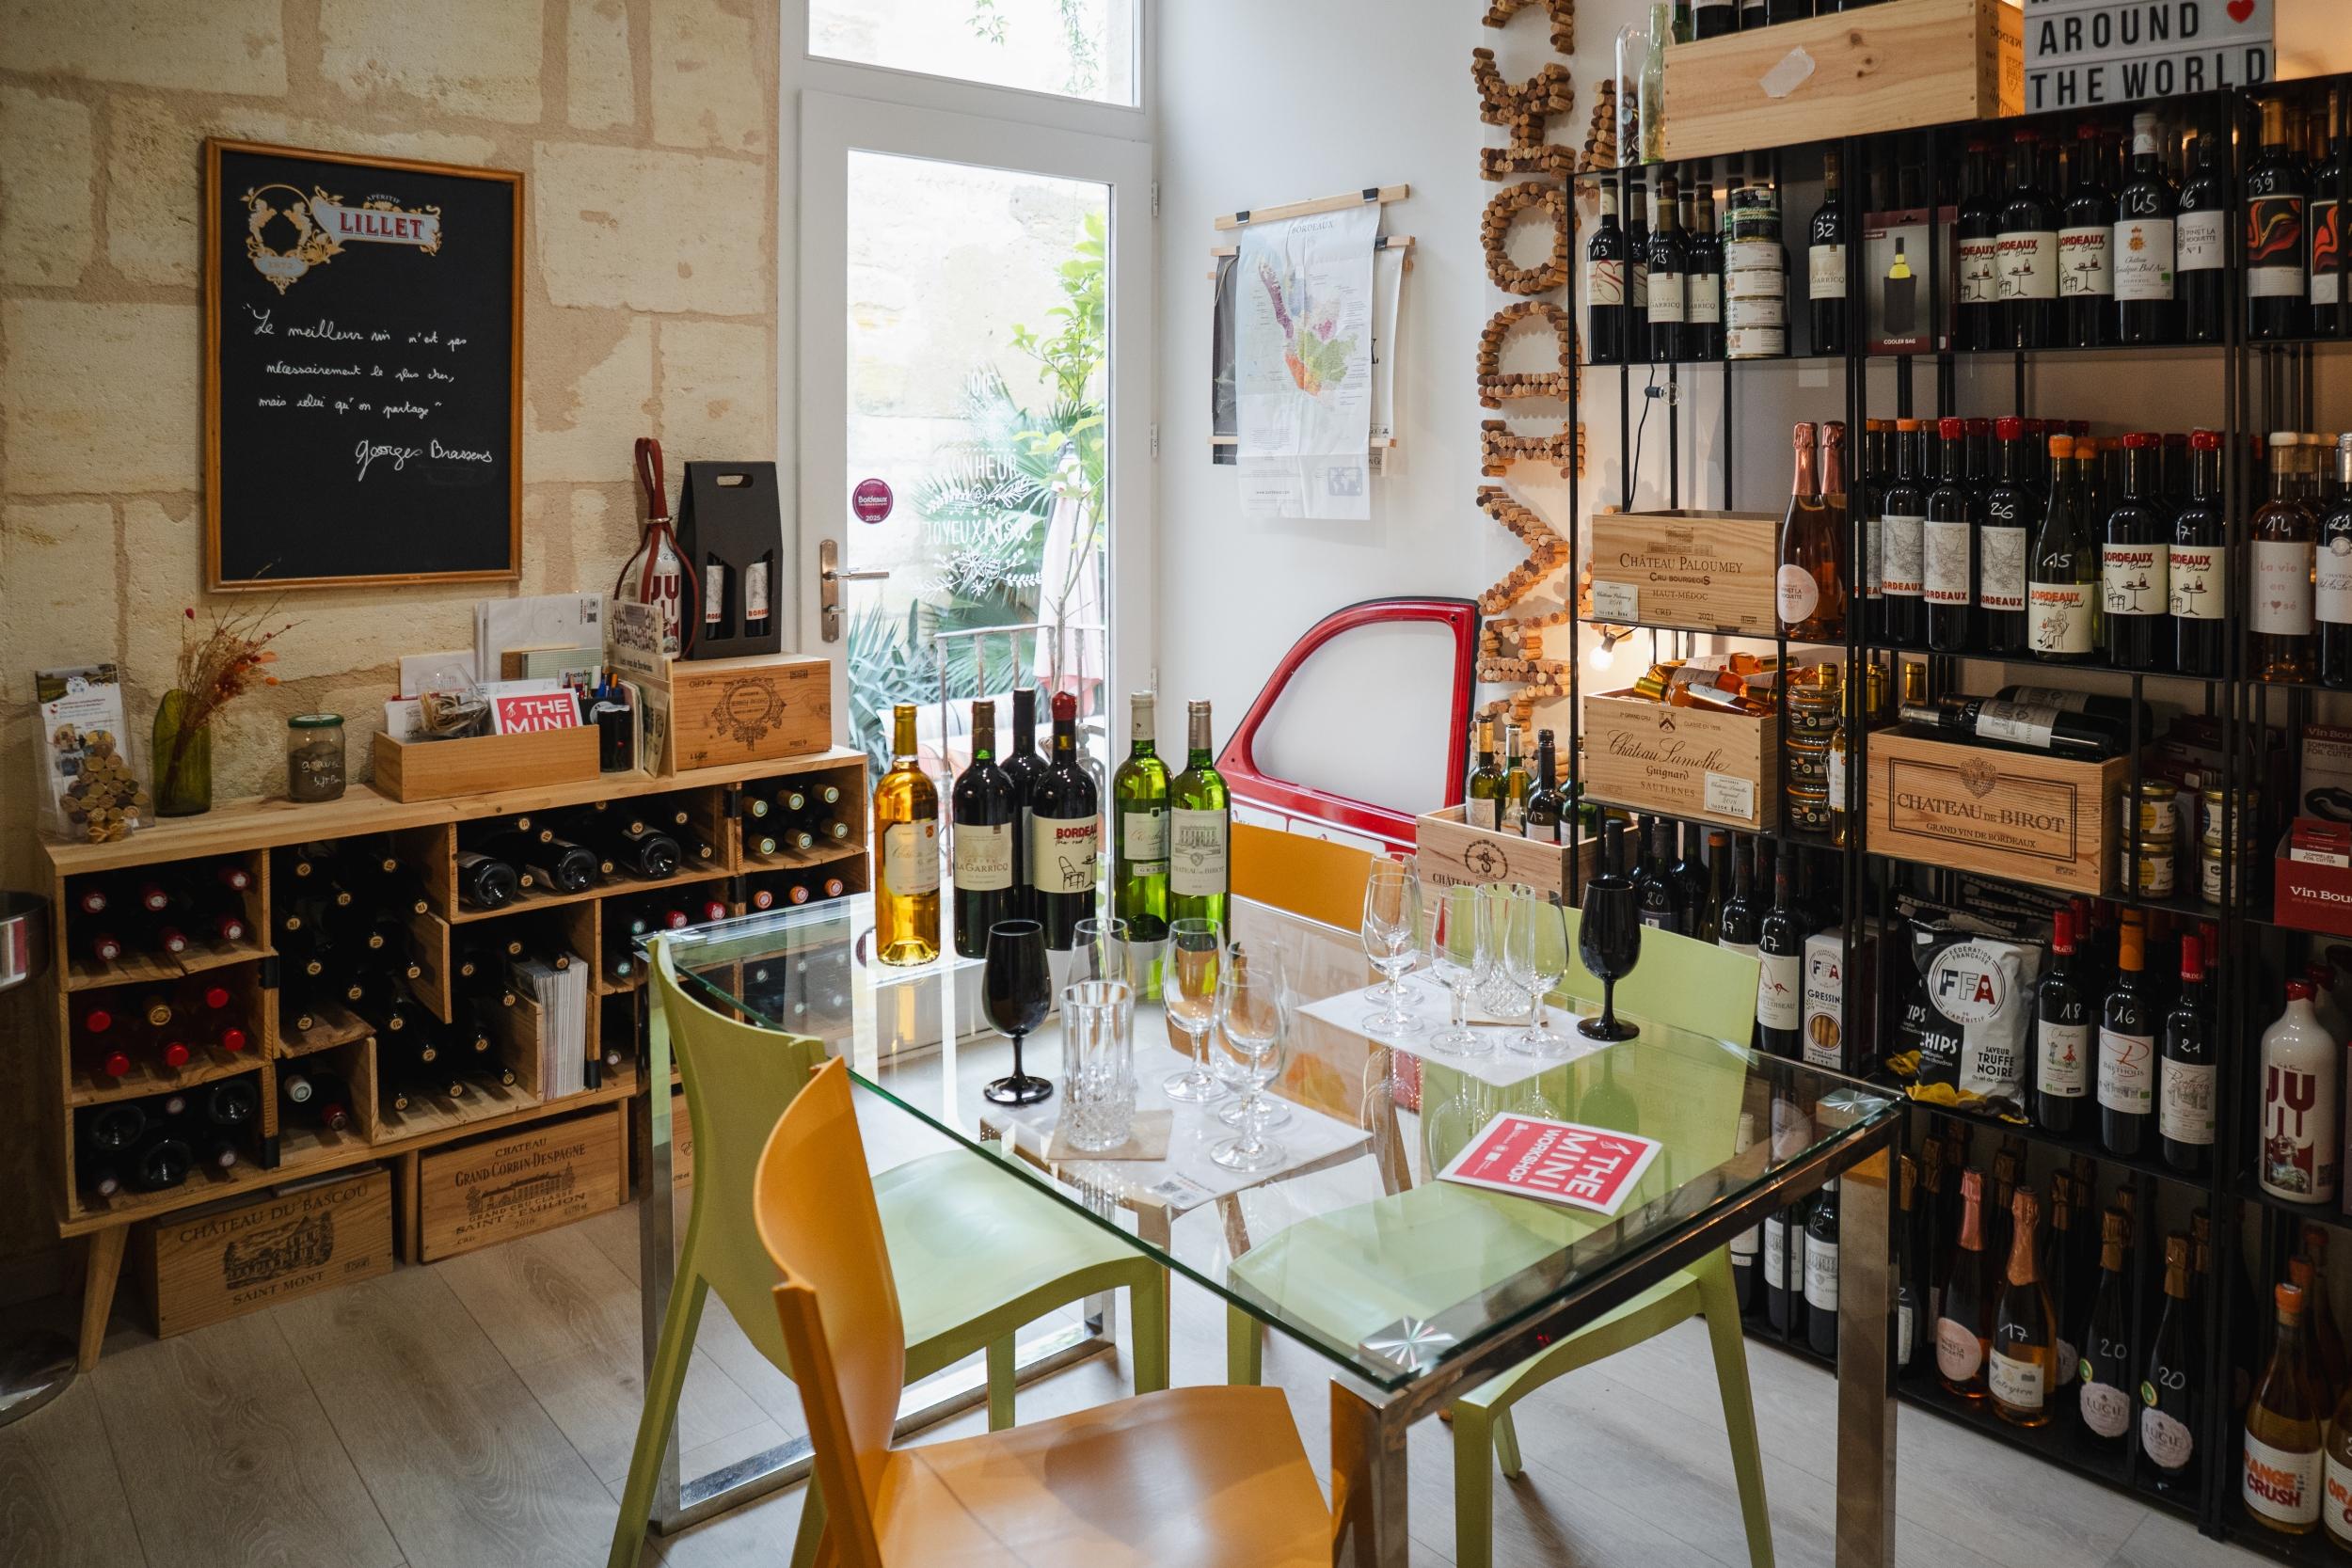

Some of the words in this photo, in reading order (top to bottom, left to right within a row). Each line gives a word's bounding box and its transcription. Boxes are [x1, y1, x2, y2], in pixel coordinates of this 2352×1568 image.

[2038, 1, 2200, 56] AROUND
[2029, 67, 2105, 109] THE
[2122, 47, 2267, 101] WORLD
[2132, 194, 2157, 214] 45
[2179, 188, 2195, 208] 16
[340, 212, 424, 240] LILLET
[1815, 222, 1835, 240] 32
[1592, 245, 1608, 257] 13
[288, 319, 364, 341] meilleur
[371, 330, 390, 342] vin
[372, 365, 384, 377] le
[395, 368, 419, 382] plus
[259, 397, 286, 408] mais
[296, 396, 326, 408] celui
[355, 440, 423, 482] Georges
[1990, 502, 2013, 518] 26
[2265, 516, 2291, 536] 14
[1620, 552, 1676, 569] CHÂTEAU
[1679, 556, 1744, 574] PALOUMEY
[2104, 551, 2153, 563] BORDEAUX
[2260, 562, 2273, 572] La
[2279, 562, 2297, 572] vie
[1649, 572, 1667, 582] CRU
[2030, 590, 2080, 603] BORDEAUX
[1655, 608, 1672, 616] CRD
[1697, 612, 1714, 622] 2021
[520, 699, 570, 720] THE
[505, 714, 572, 735] MINI
[2329, 730, 2352, 740] Bou
[1607, 729, 1659, 762] Château
[1658, 737, 1731, 772] Lamothe
[1640, 781, 1695, 798] SAUTERNES
[1897, 792, 1982, 821] CHATEAU
[1983, 811, 1997, 823] DE
[1999, 809, 2065, 833] BIROT
[1926, 822, 1957, 834] GRAND
[1957, 826, 1974, 837] VIN
[1974, 829, 1987, 840] DE
[1988, 832, 2037, 849] BORDEAUX
[2290, 886, 2316, 897] Vin
[2319, 890, 2352, 904] Bou
[1759, 935, 1780, 952] 17
[1812, 958, 1840, 980] FFA
[1807, 989, 1842, 1005] GRESSIN
[1938, 968, 1996, 1006] FFA
[1907, 1005, 1927, 1023] IPS
[2059, 1003, 2081, 1019] 18
[2114, 1006, 2137, 1025] 16
[1978, 1052, 2015, 1067] TRUFFE
[1985, 1045, 2010, 1055] SAVEUR
[1977, 1063, 2014, 1079] NOIRE
[1507, 1128, 1563, 1183] WORKSHOP
[1527, 1131, 1597, 1189] MINI
[1564, 1155, 1623, 1198] THE
[271, 1202, 296, 1221] DU
[302, 1184, 370, 1212] BASCOU
[232, 1285, 278, 1307] SAINT
[283, 1271, 326, 1292] MONT
[1999, 1322, 2028, 1342] 17
[2100, 1338, 2127, 1359] 20
[2158, 1366, 2186, 1390] 20
[2247, 1472, 2302, 1508] CRUSH
